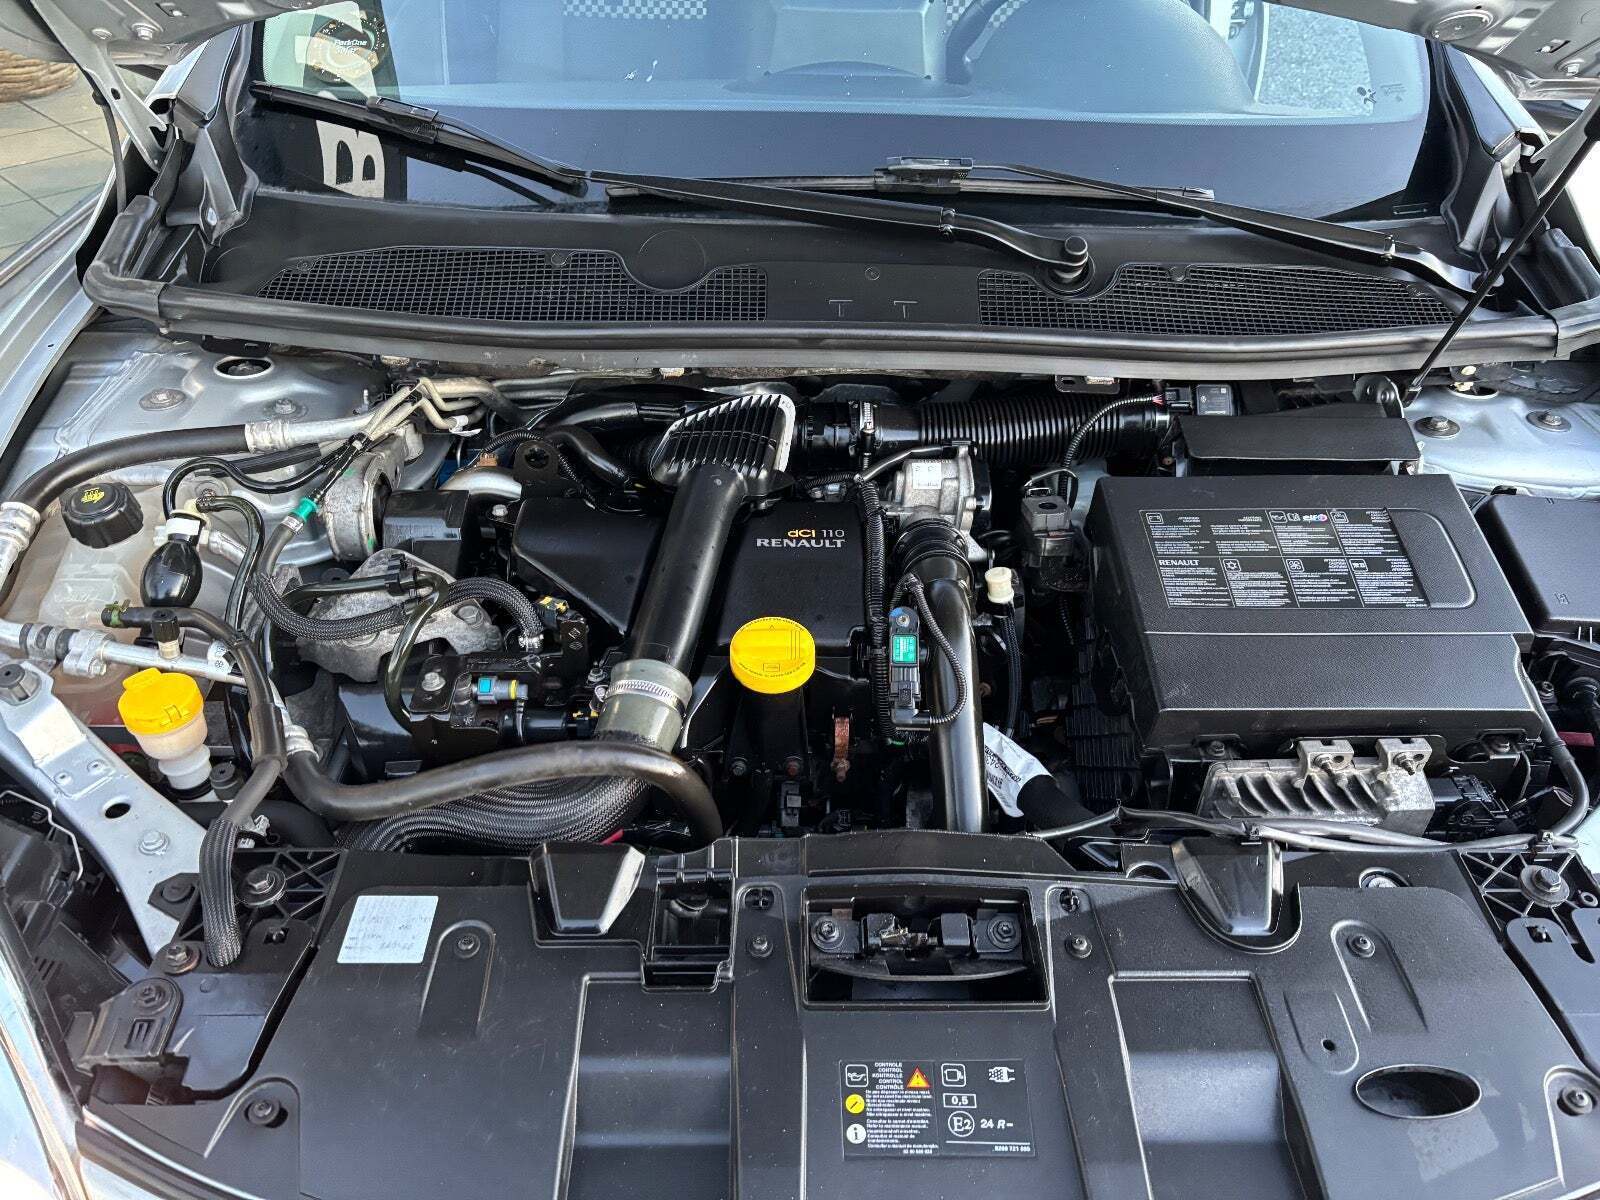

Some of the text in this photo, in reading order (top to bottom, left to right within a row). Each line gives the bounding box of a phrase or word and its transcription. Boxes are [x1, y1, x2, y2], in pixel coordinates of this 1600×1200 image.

[822, 529, 846, 538] 110
[756, 538, 846, 548] RENAULT
[1158, 559, 1200, 567] RENAULT
[951, 1095, 969, 1106] 0,5
[952, 1117, 972, 1132] E2
[980, 1119, 994, 1128] 24
